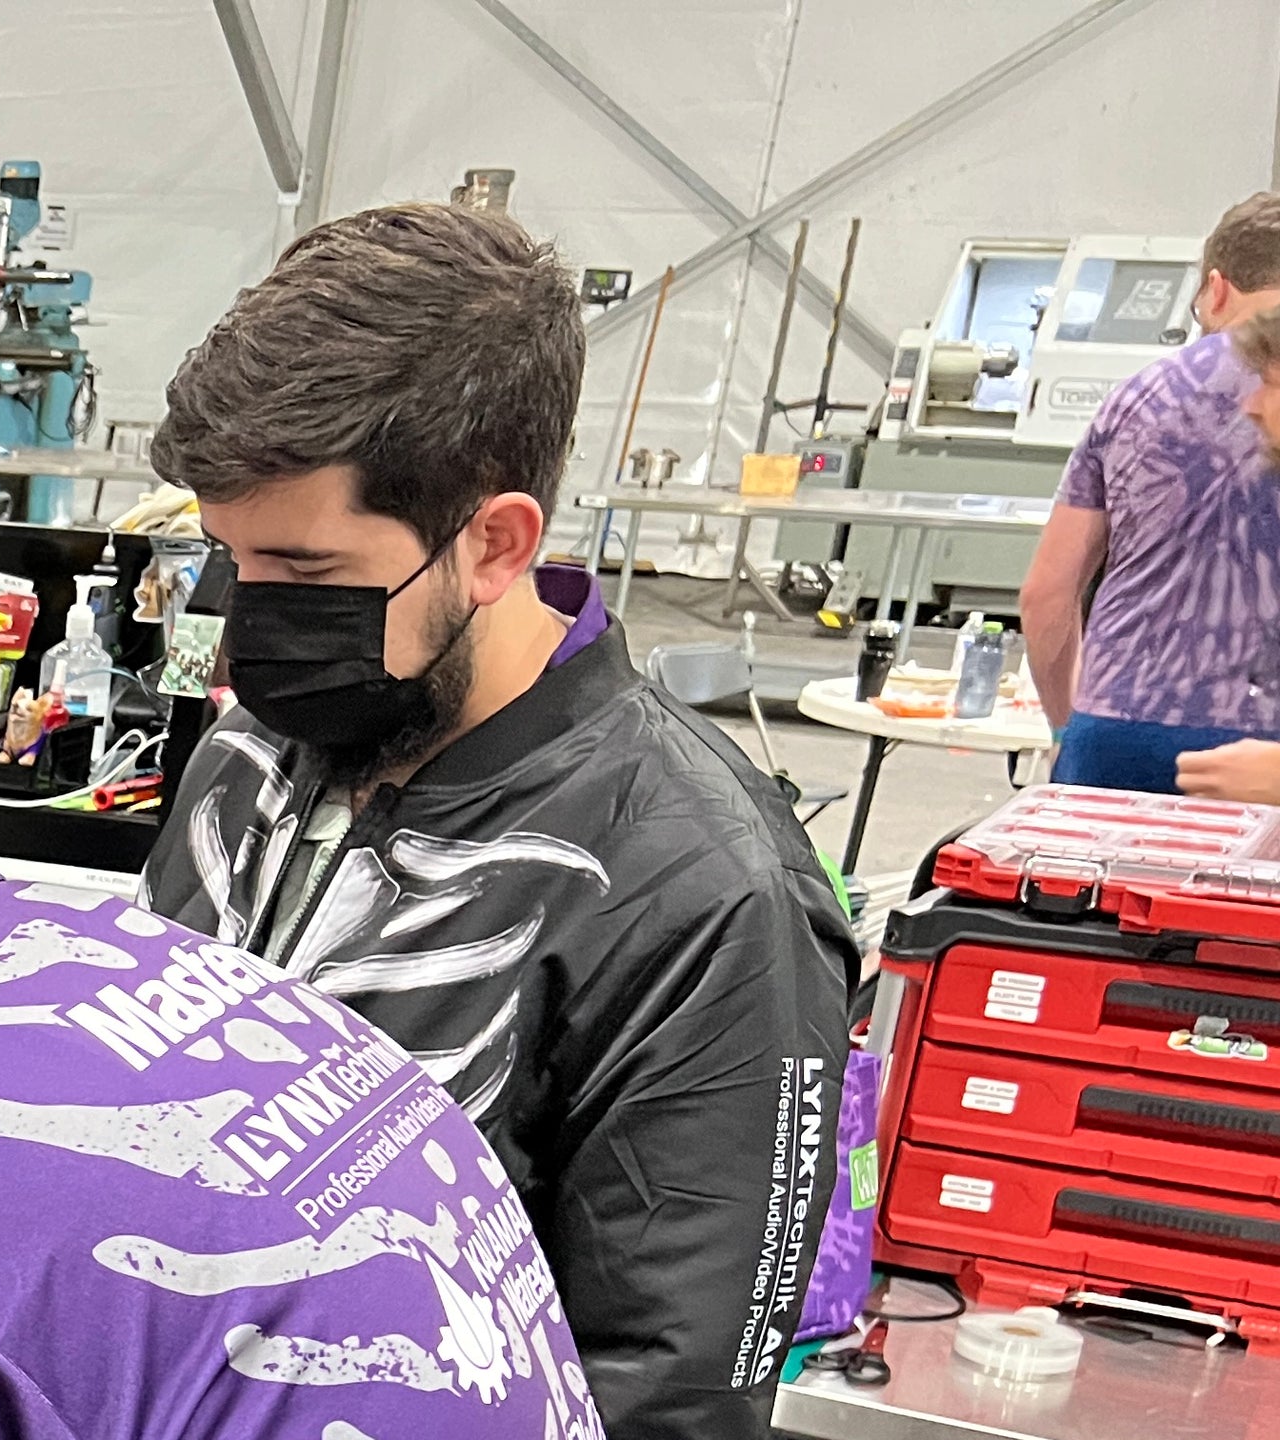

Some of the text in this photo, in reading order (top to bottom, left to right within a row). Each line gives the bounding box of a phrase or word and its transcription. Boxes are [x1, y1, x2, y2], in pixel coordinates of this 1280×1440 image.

[730, 1056, 794, 1389] Professional Audio/Video Products
[754, 1057, 824, 1385] LYNXTechnik AG
